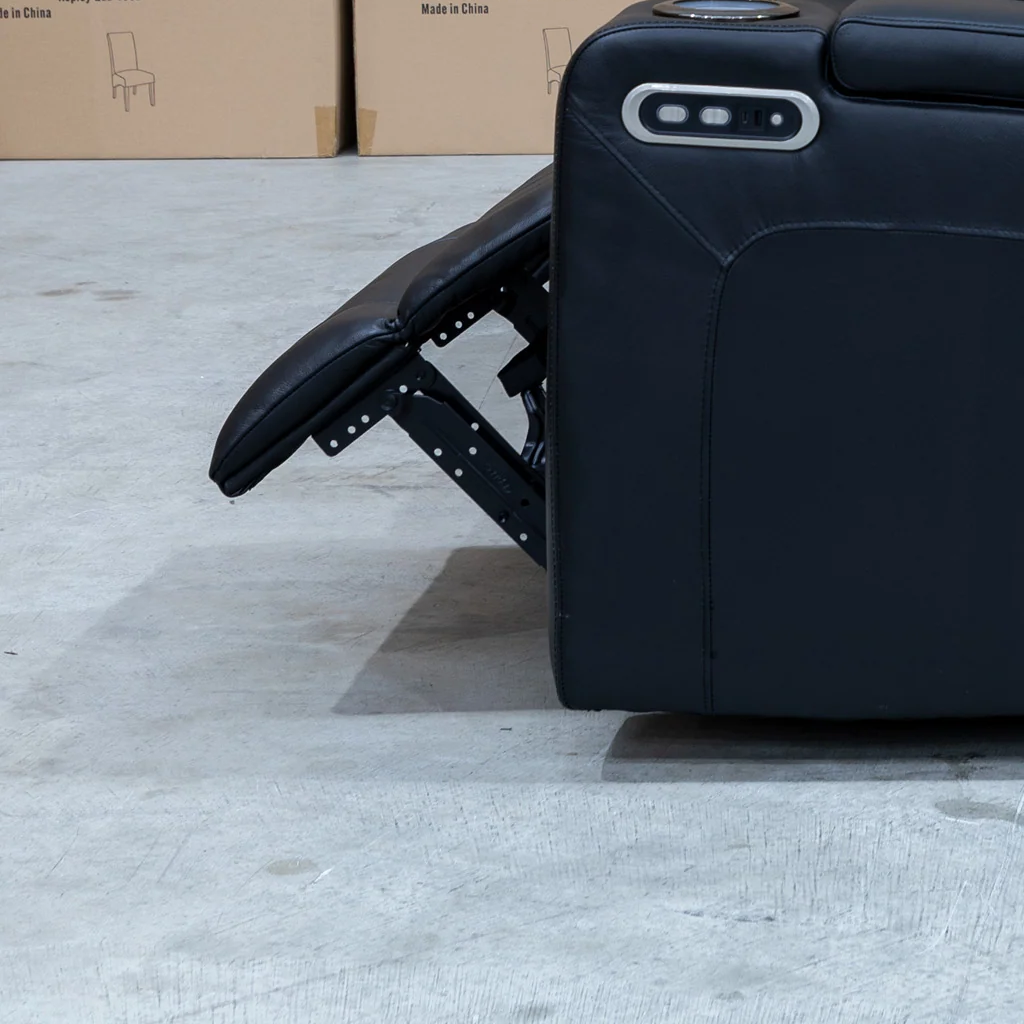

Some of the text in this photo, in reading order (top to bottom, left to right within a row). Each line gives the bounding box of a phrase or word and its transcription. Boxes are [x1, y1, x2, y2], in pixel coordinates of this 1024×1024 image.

[421, 2, 488, 14] Made in China
